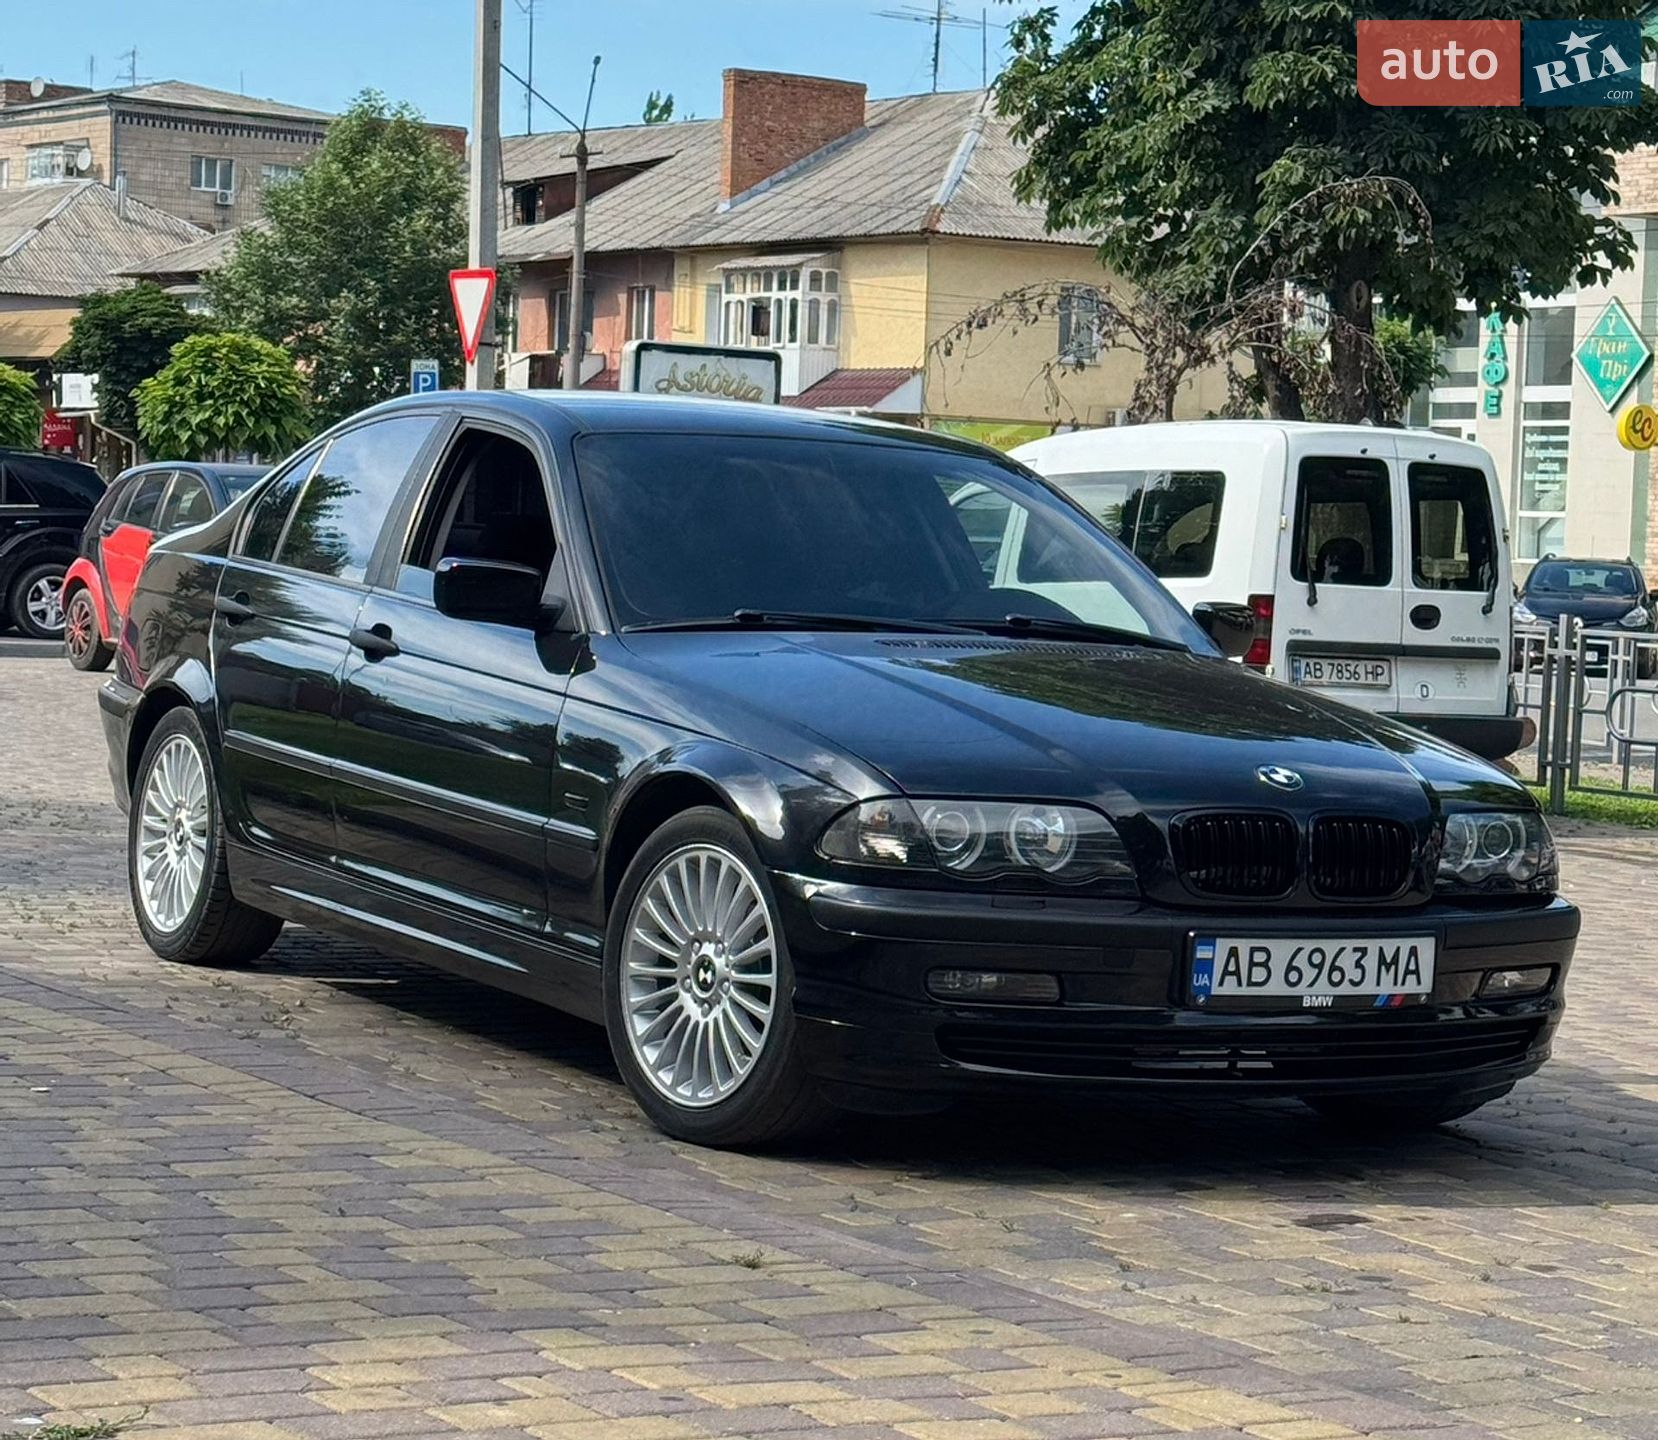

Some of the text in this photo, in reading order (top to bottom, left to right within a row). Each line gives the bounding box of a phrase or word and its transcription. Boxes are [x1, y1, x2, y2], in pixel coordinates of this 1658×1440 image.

[1588, 337, 1628, 358] Гран
[420, 374, 431, 392] P
[655, 361, 764, 400] Astoria
[1289, 628, 1313, 636] OPEL
[1303, 662, 1385, 681] AB 7856 HP
[1218, 945, 1422, 988] AB 6963 MA
[1193, 973, 1210, 986] UA
[1303, 996, 1334, 1007] BMW
